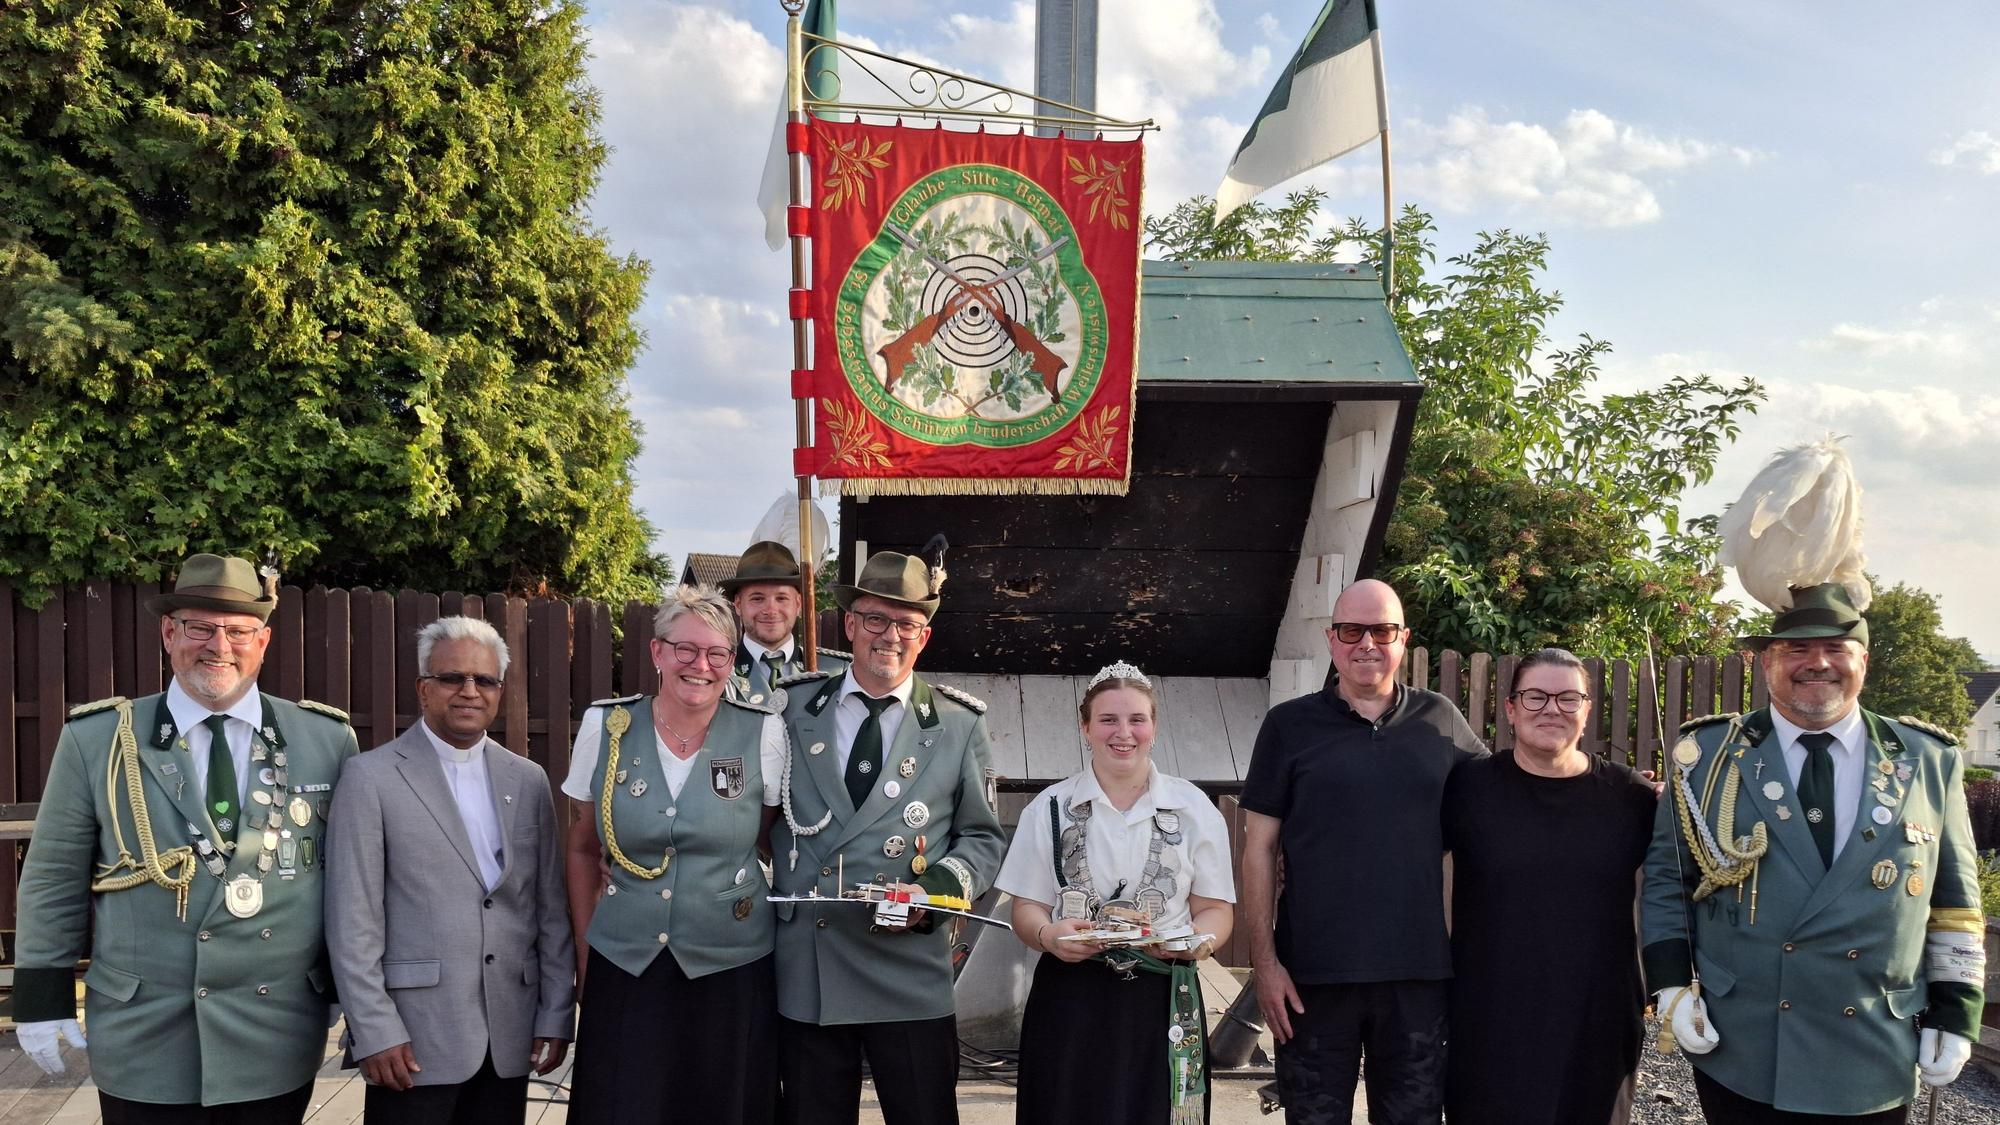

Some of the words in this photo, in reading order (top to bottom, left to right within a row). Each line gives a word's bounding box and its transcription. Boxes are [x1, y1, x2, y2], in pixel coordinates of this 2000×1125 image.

[895, 178, 946, 224] Glaube
[962, 170, 999, 187] Sitte
[1014, 181, 1064, 234] Heimat
[843, 302, 889, 410] Sebastianus
[891, 407, 968, 437] Schützen
[973, 402, 1069, 439] bruderschaft
[1066, 314, 1100, 401] Weilerswist
